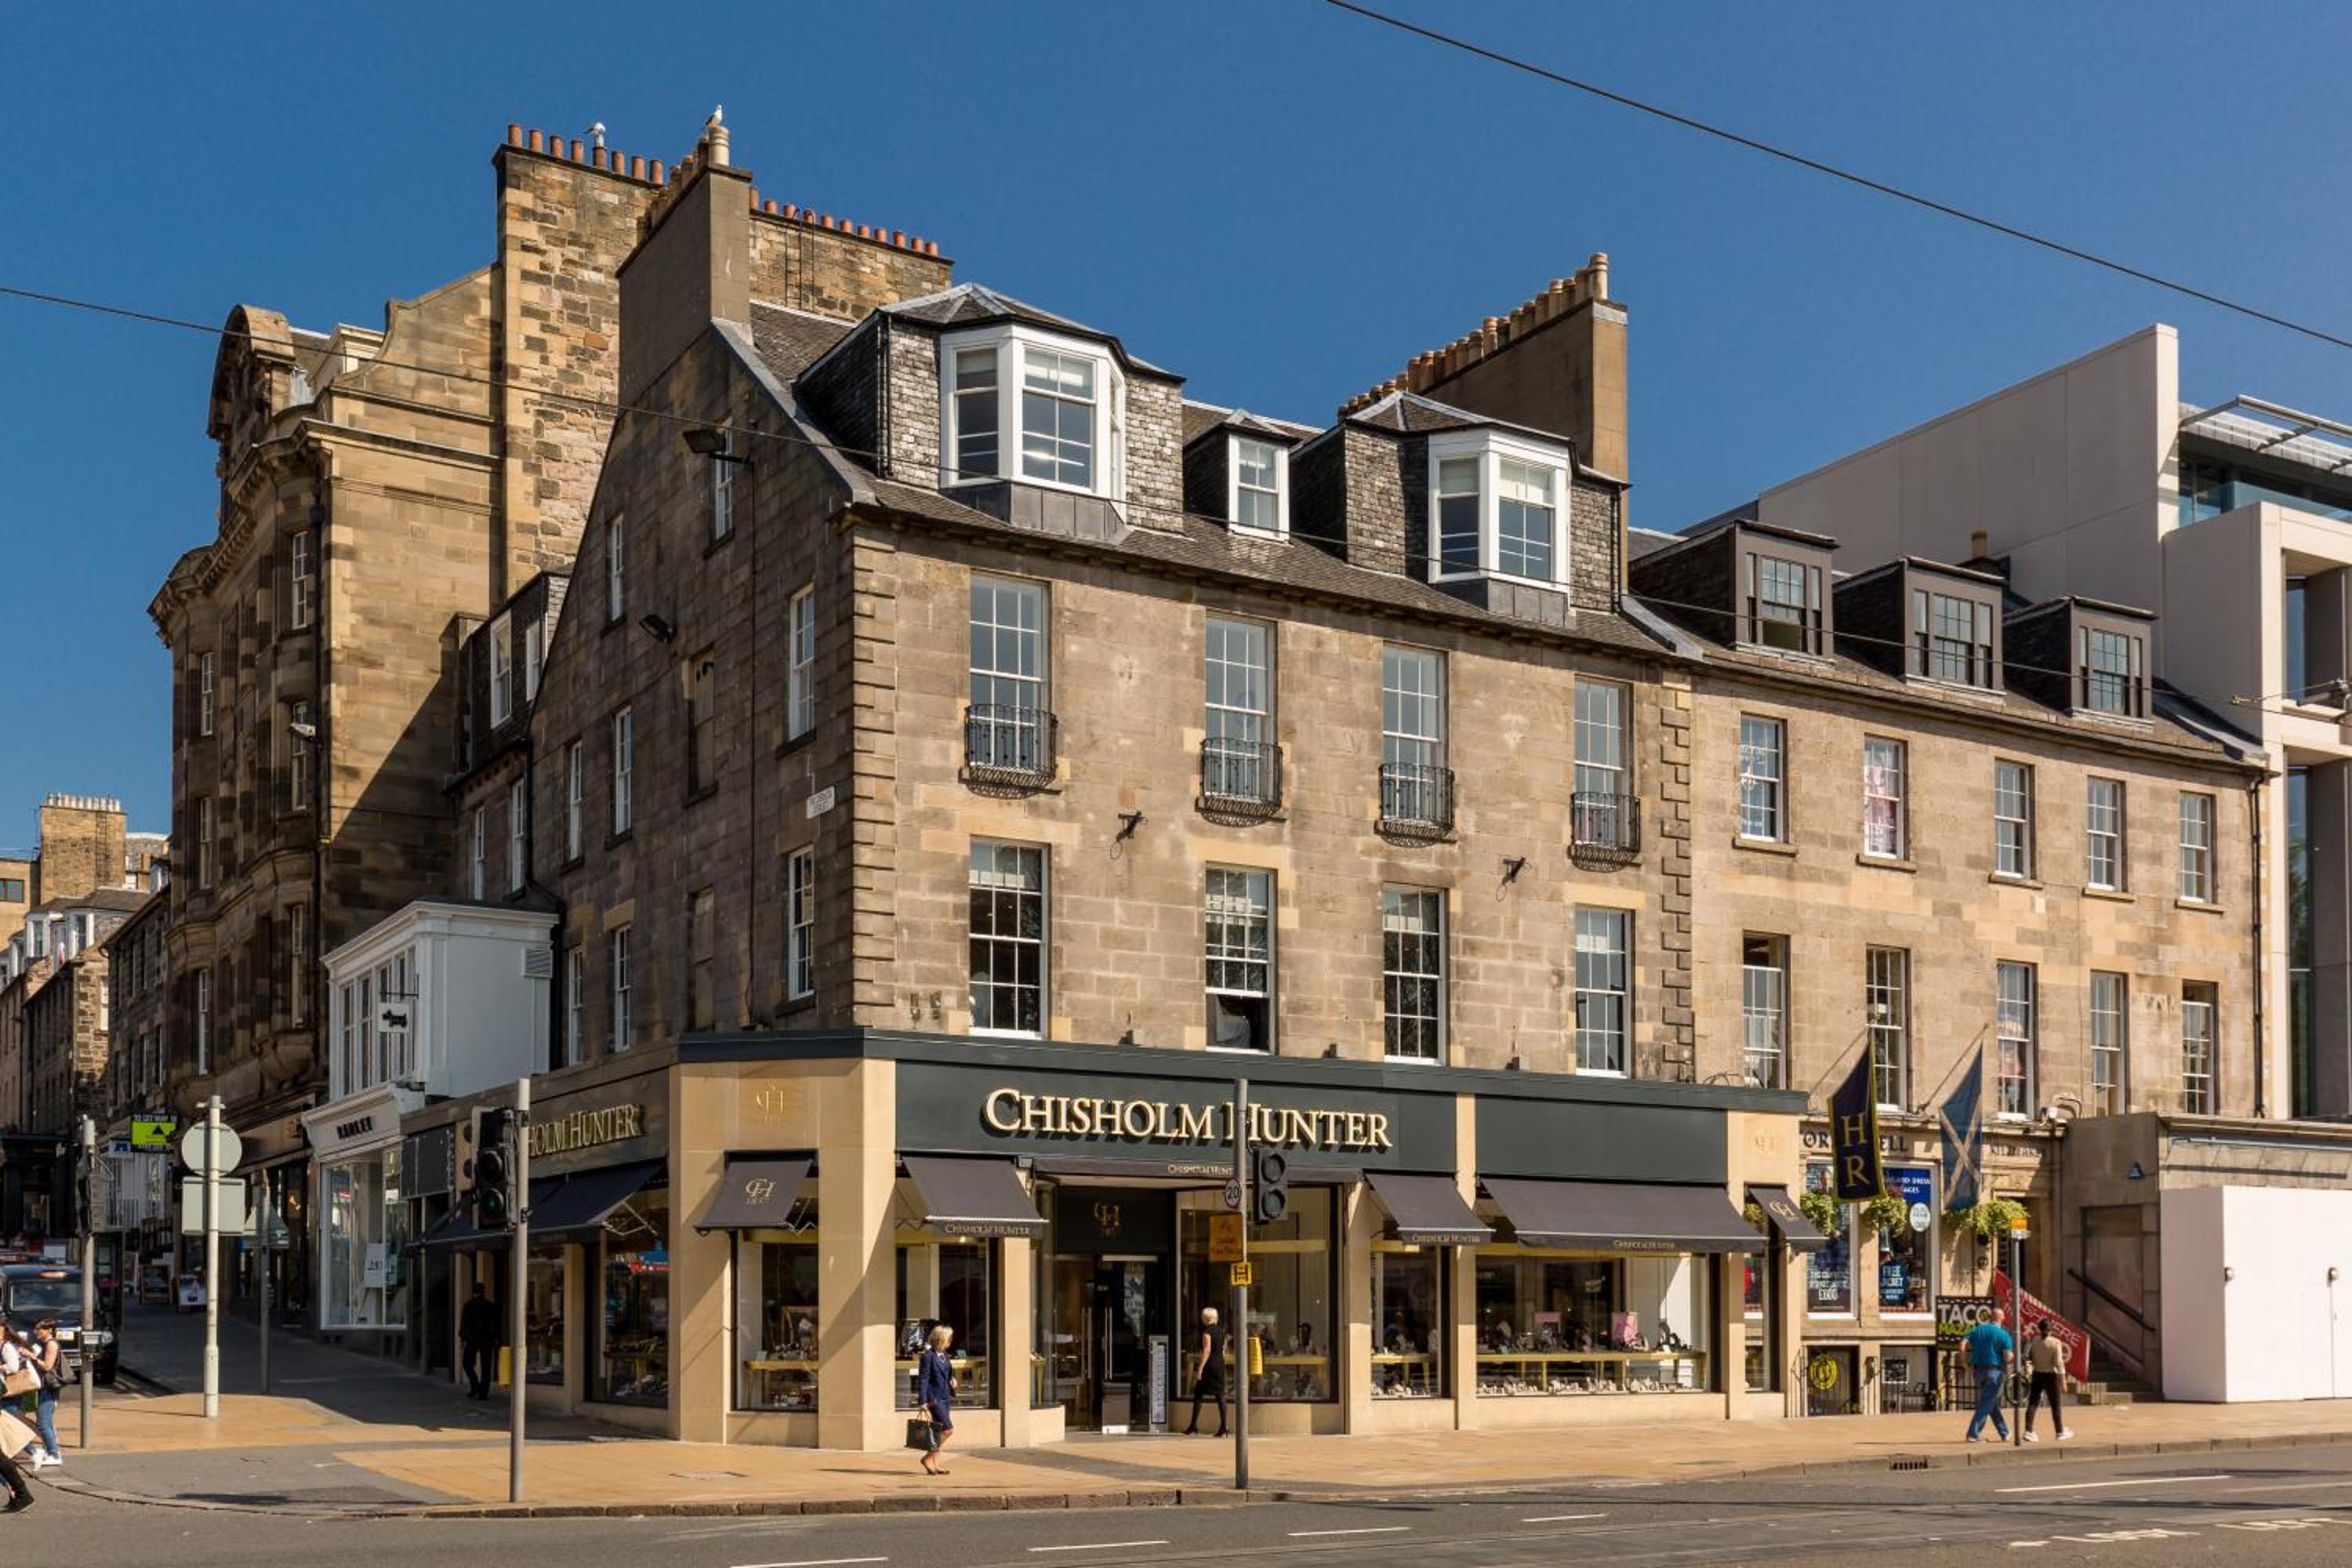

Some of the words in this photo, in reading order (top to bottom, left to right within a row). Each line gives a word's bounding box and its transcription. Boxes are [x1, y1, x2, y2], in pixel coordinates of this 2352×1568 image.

[528, 1119, 566, 1156] HOLM
[571, 1104, 638, 1149] HUNTER
[985, 1088, 1214, 1140] CHISHOLM
[1225, 1102, 1392, 1147] HUNTER
[1841, 1112, 1868, 1147] H
[1211, 1166, 1234, 1176] HUNT
[1844, 1155, 1870, 1188] R
[1228, 1186, 1240, 1200] 20
[945, 1223, 995, 1234] CHISHOLM
[996, 1225, 1031, 1235] HUNTER
[1937, 1304, 1992, 1325] TACO
